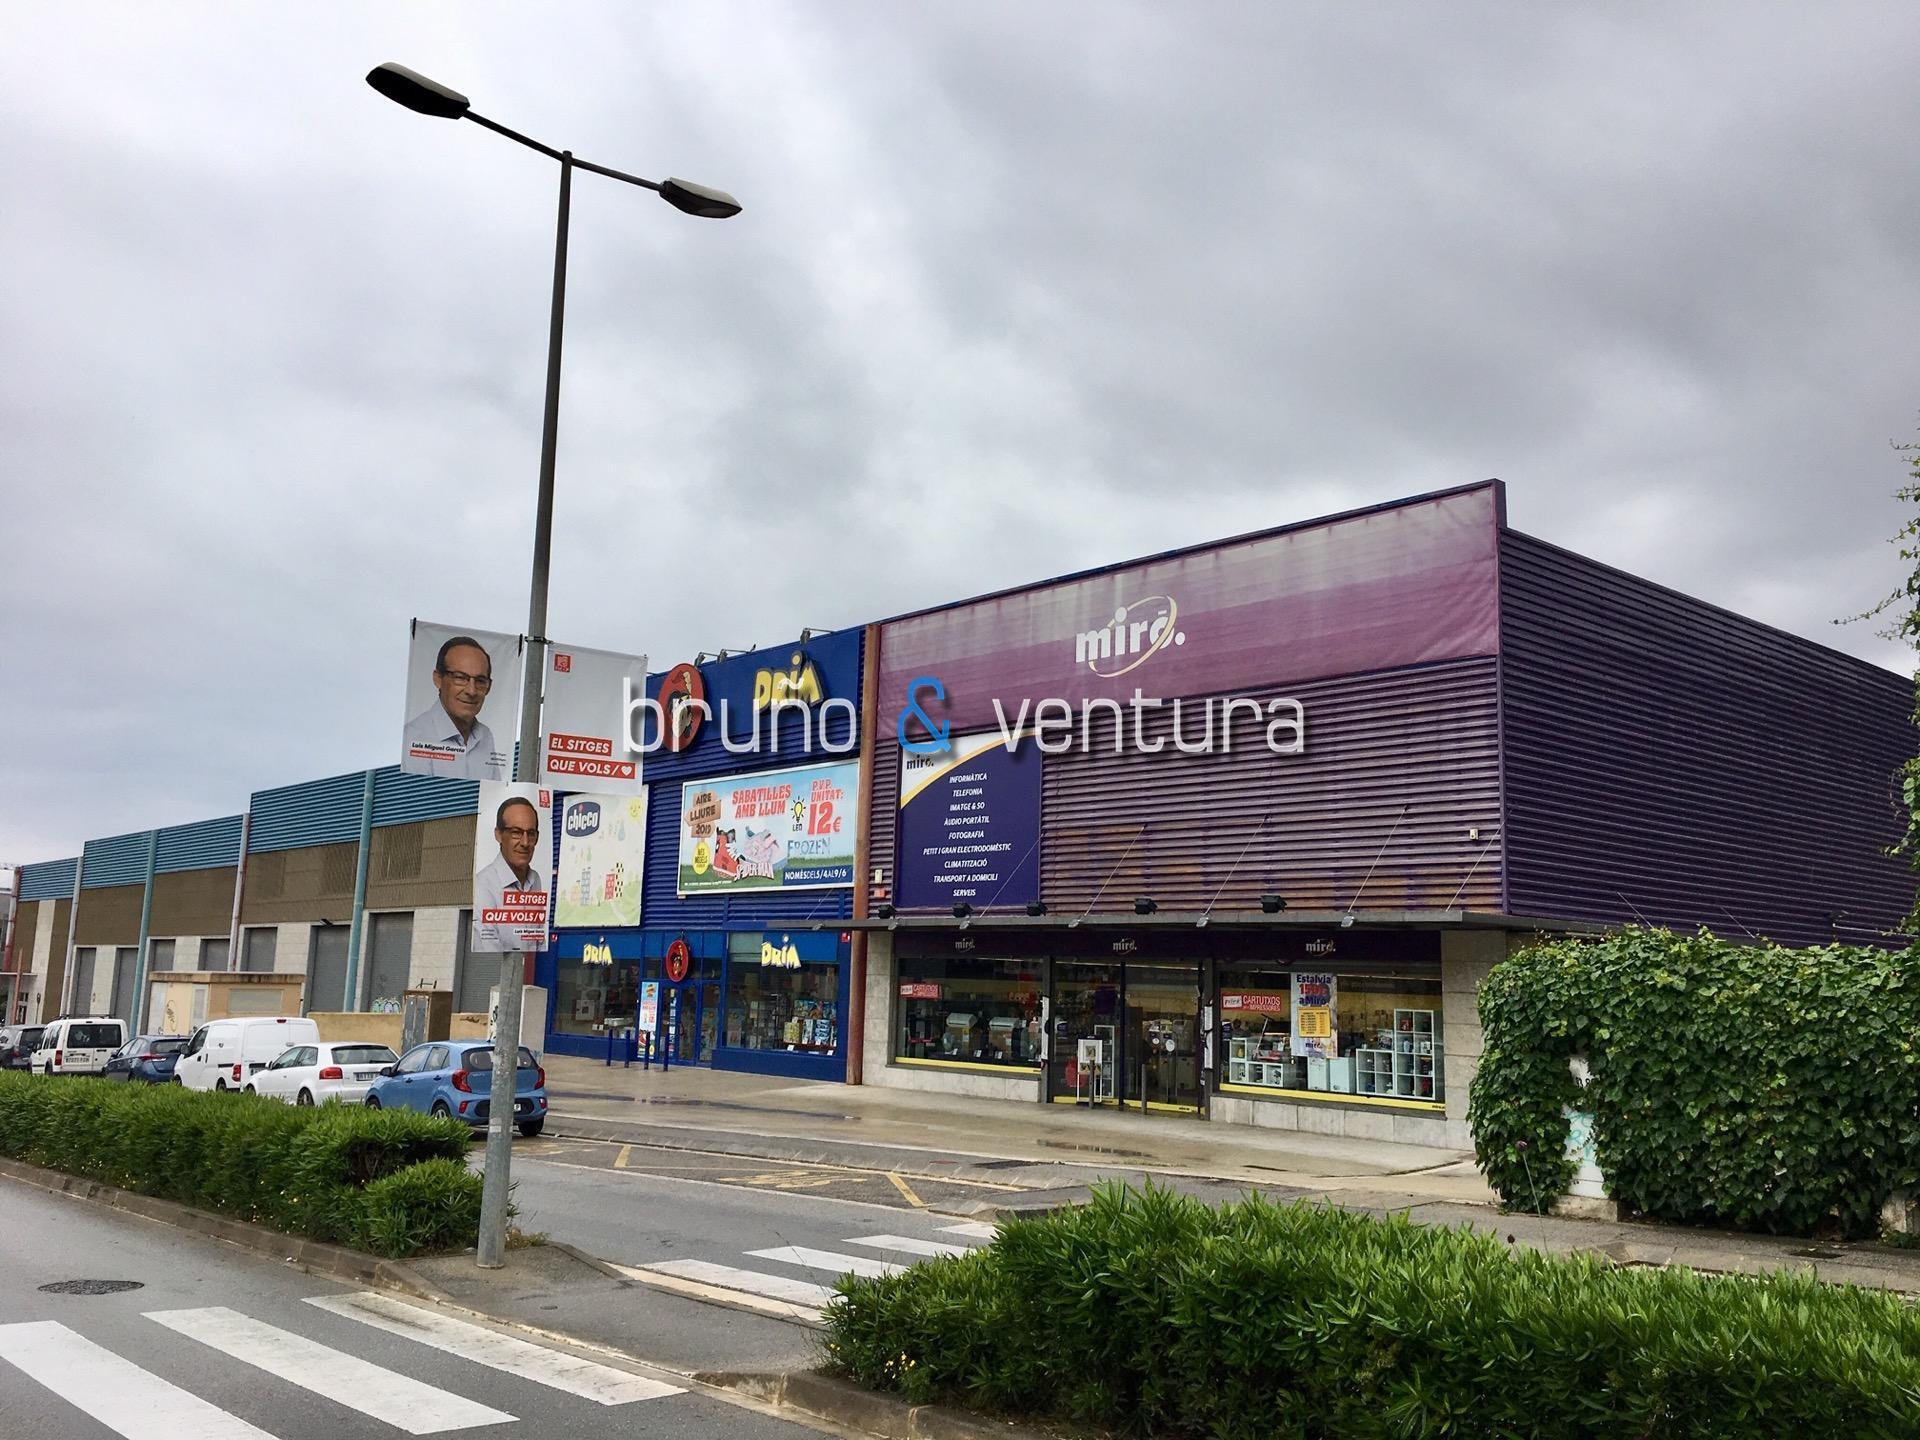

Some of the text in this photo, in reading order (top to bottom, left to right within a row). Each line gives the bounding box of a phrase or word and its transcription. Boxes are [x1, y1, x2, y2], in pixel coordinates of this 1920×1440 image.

[551, 738, 610, 754] EL SITGES
[550, 759, 576, 772] QUE
[949, 773, 988, 784] INFORMÀTICA
[732, 784, 792, 804] SABATILLES
[953, 788, 983, 797] TELEFONIA
[695, 793, 712, 805] AIRE
[735, 799, 786, 819] AMB LLUM
[950, 803, 971, 811] IMATGE
[567, 805, 599, 830] chicco
[690, 805, 716, 821] LLIURE
[962, 815, 990, 825] PORTÀTIL
[695, 824, 712, 835] 2019
[792, 824, 803, 832] LED
[949, 830, 984, 840] FOTOGRAFIA
[941, 846, 957, 854] GRAN
[957, 843, 1011, 853] ELECTRODOMÈSTIC
[944, 858, 988, 868] CLIMATITZACIÓ
[933, 875, 966, 883] TRANSPORT
[972, 873, 998, 882] DOMICILI
[953, 889, 976, 897] SERVEIS
[505, 894, 546, 905] EL SITGES
[485, 911, 508, 922] QUE
[1296, 974, 1332, 984] Estalvia
[1243, 995, 1281, 1006] CARTUTXOS
